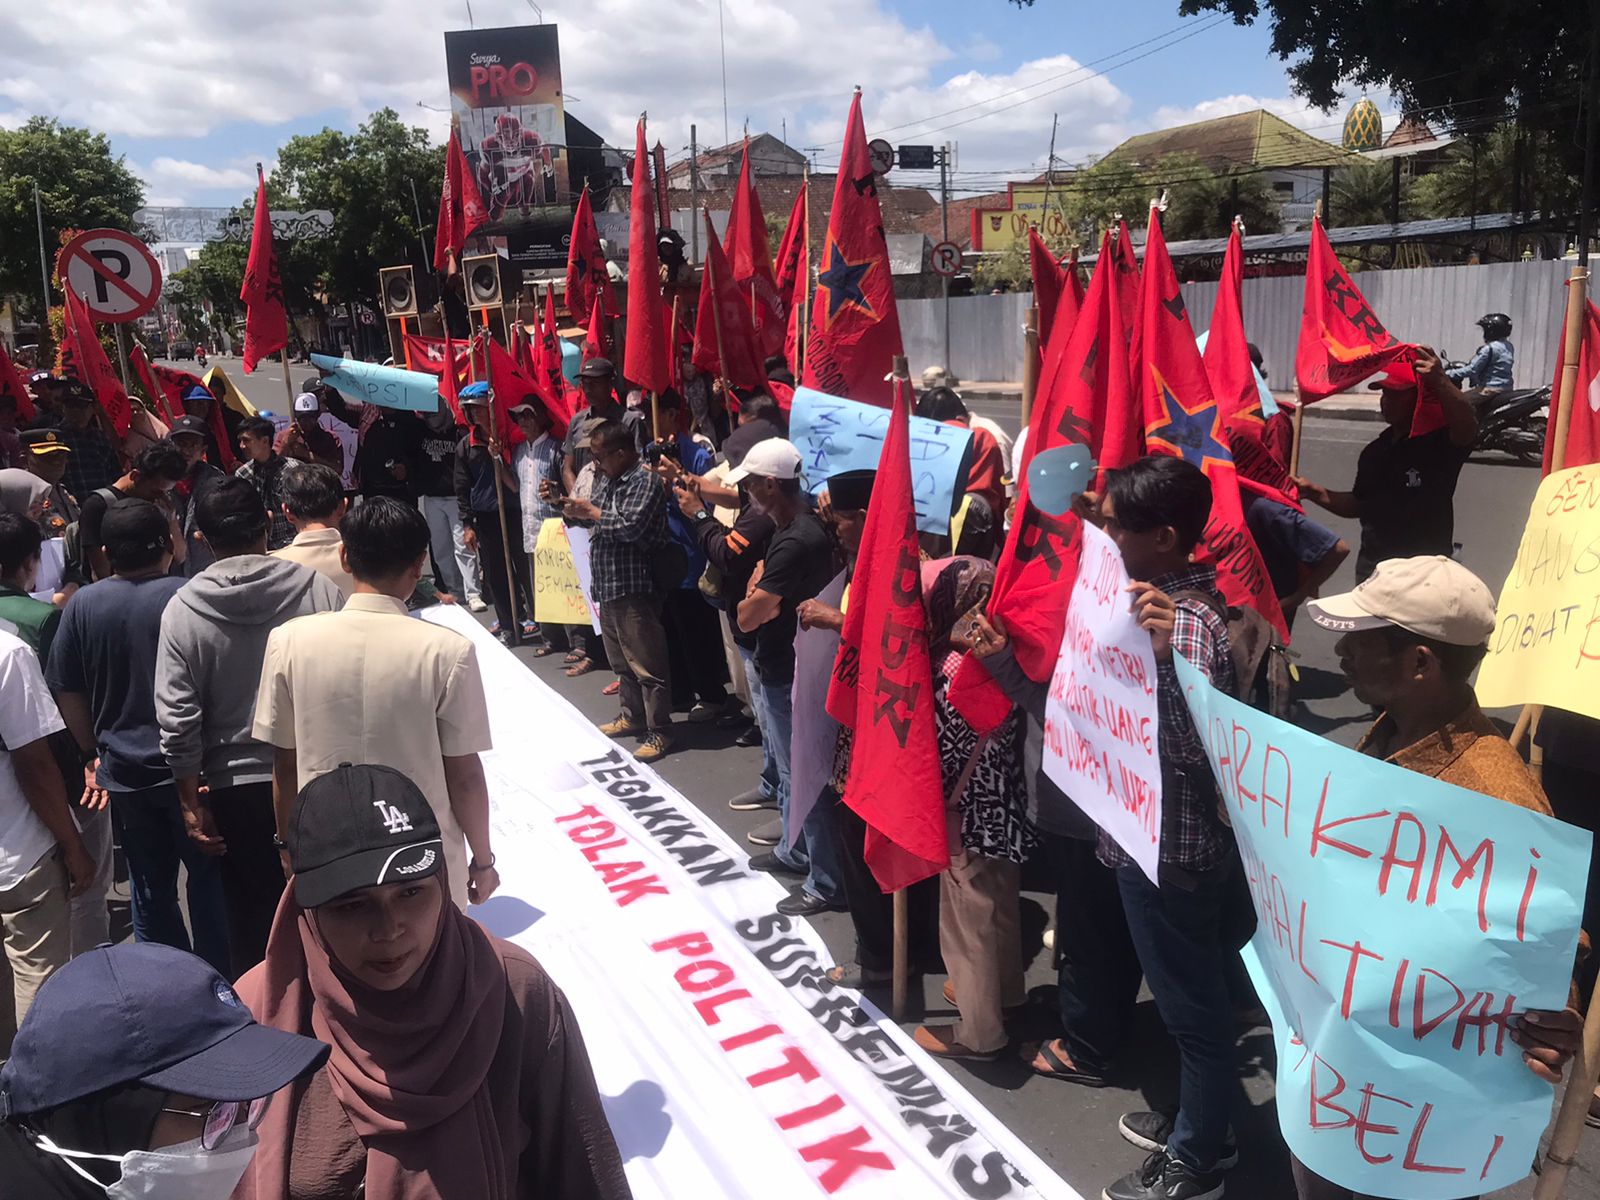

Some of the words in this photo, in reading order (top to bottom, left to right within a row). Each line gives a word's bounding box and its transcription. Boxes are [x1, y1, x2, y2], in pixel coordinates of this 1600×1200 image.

[470, 53, 501, 67] Surya
[470, 62, 538, 100] PRO
[1325, 269, 1399, 348] KR
[1314, 614, 1356, 630] LEVI'S
[373, 800, 414, 834] LA
[579, 749, 753, 888] TEGAKKAN
[554, 804, 671, 908] TOLAK
[650, 931, 896, 1195] POLITIK
